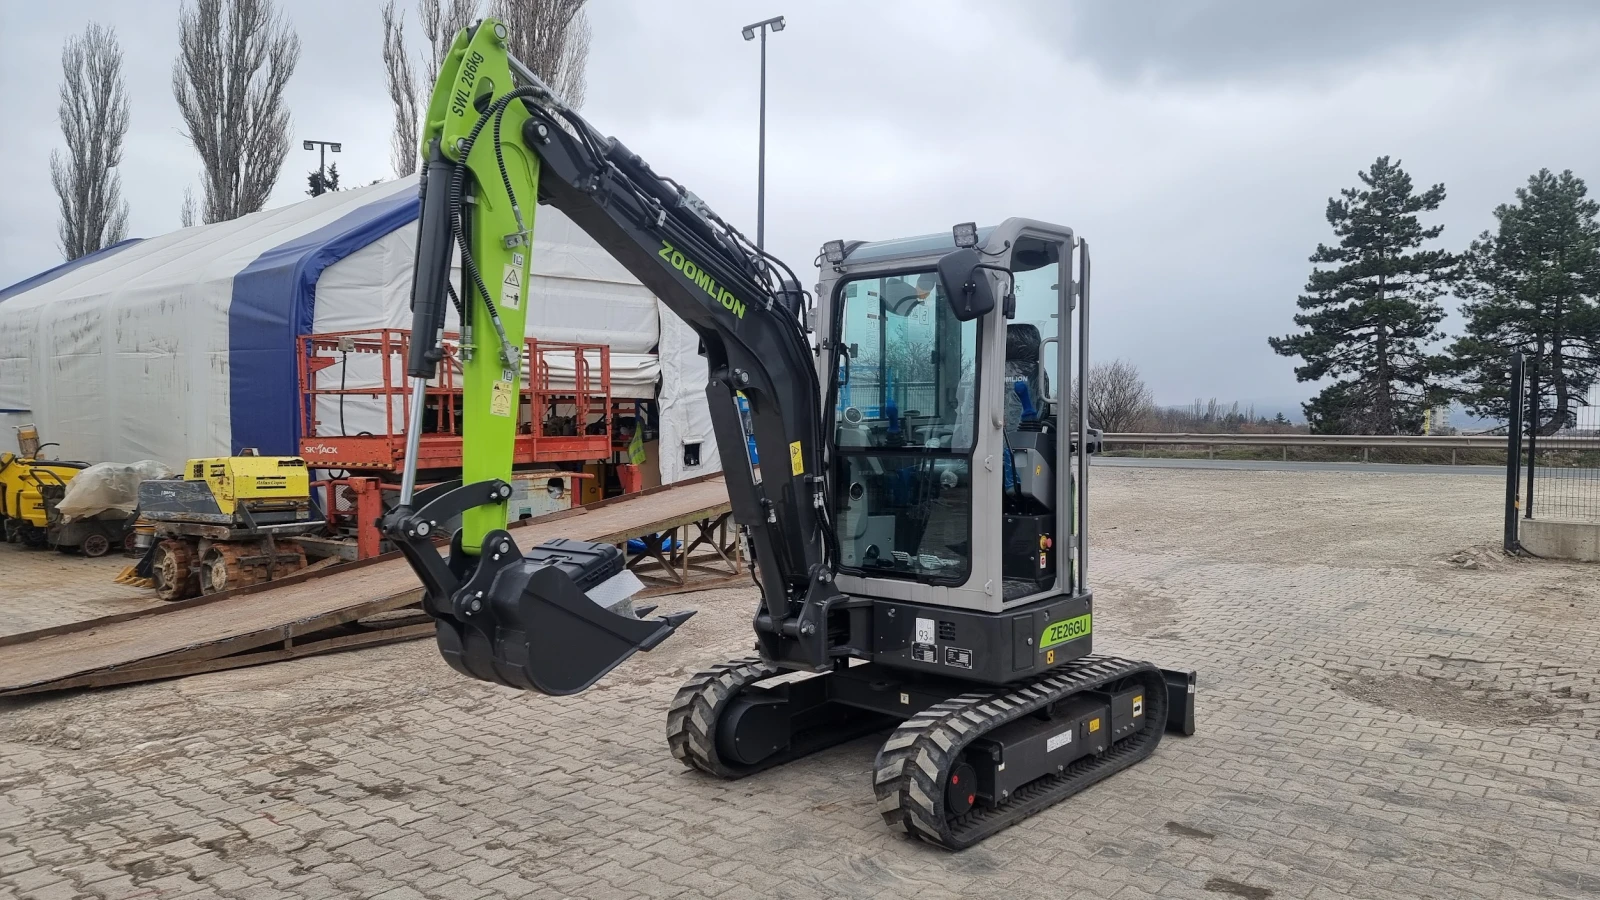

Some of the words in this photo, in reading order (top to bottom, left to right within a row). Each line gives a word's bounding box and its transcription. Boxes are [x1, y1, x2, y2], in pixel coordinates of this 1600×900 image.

[461, 51, 485, 88] 286kg
[452, 89, 471, 117] SWL
[658, 239, 746, 319] ZOOMLION
[1005, 375, 1029, 383] MLION
[305, 443, 338, 455] SKYJACK
[918, 629, 929, 641] 93
[1050, 618, 1087, 642] ZE26GU
